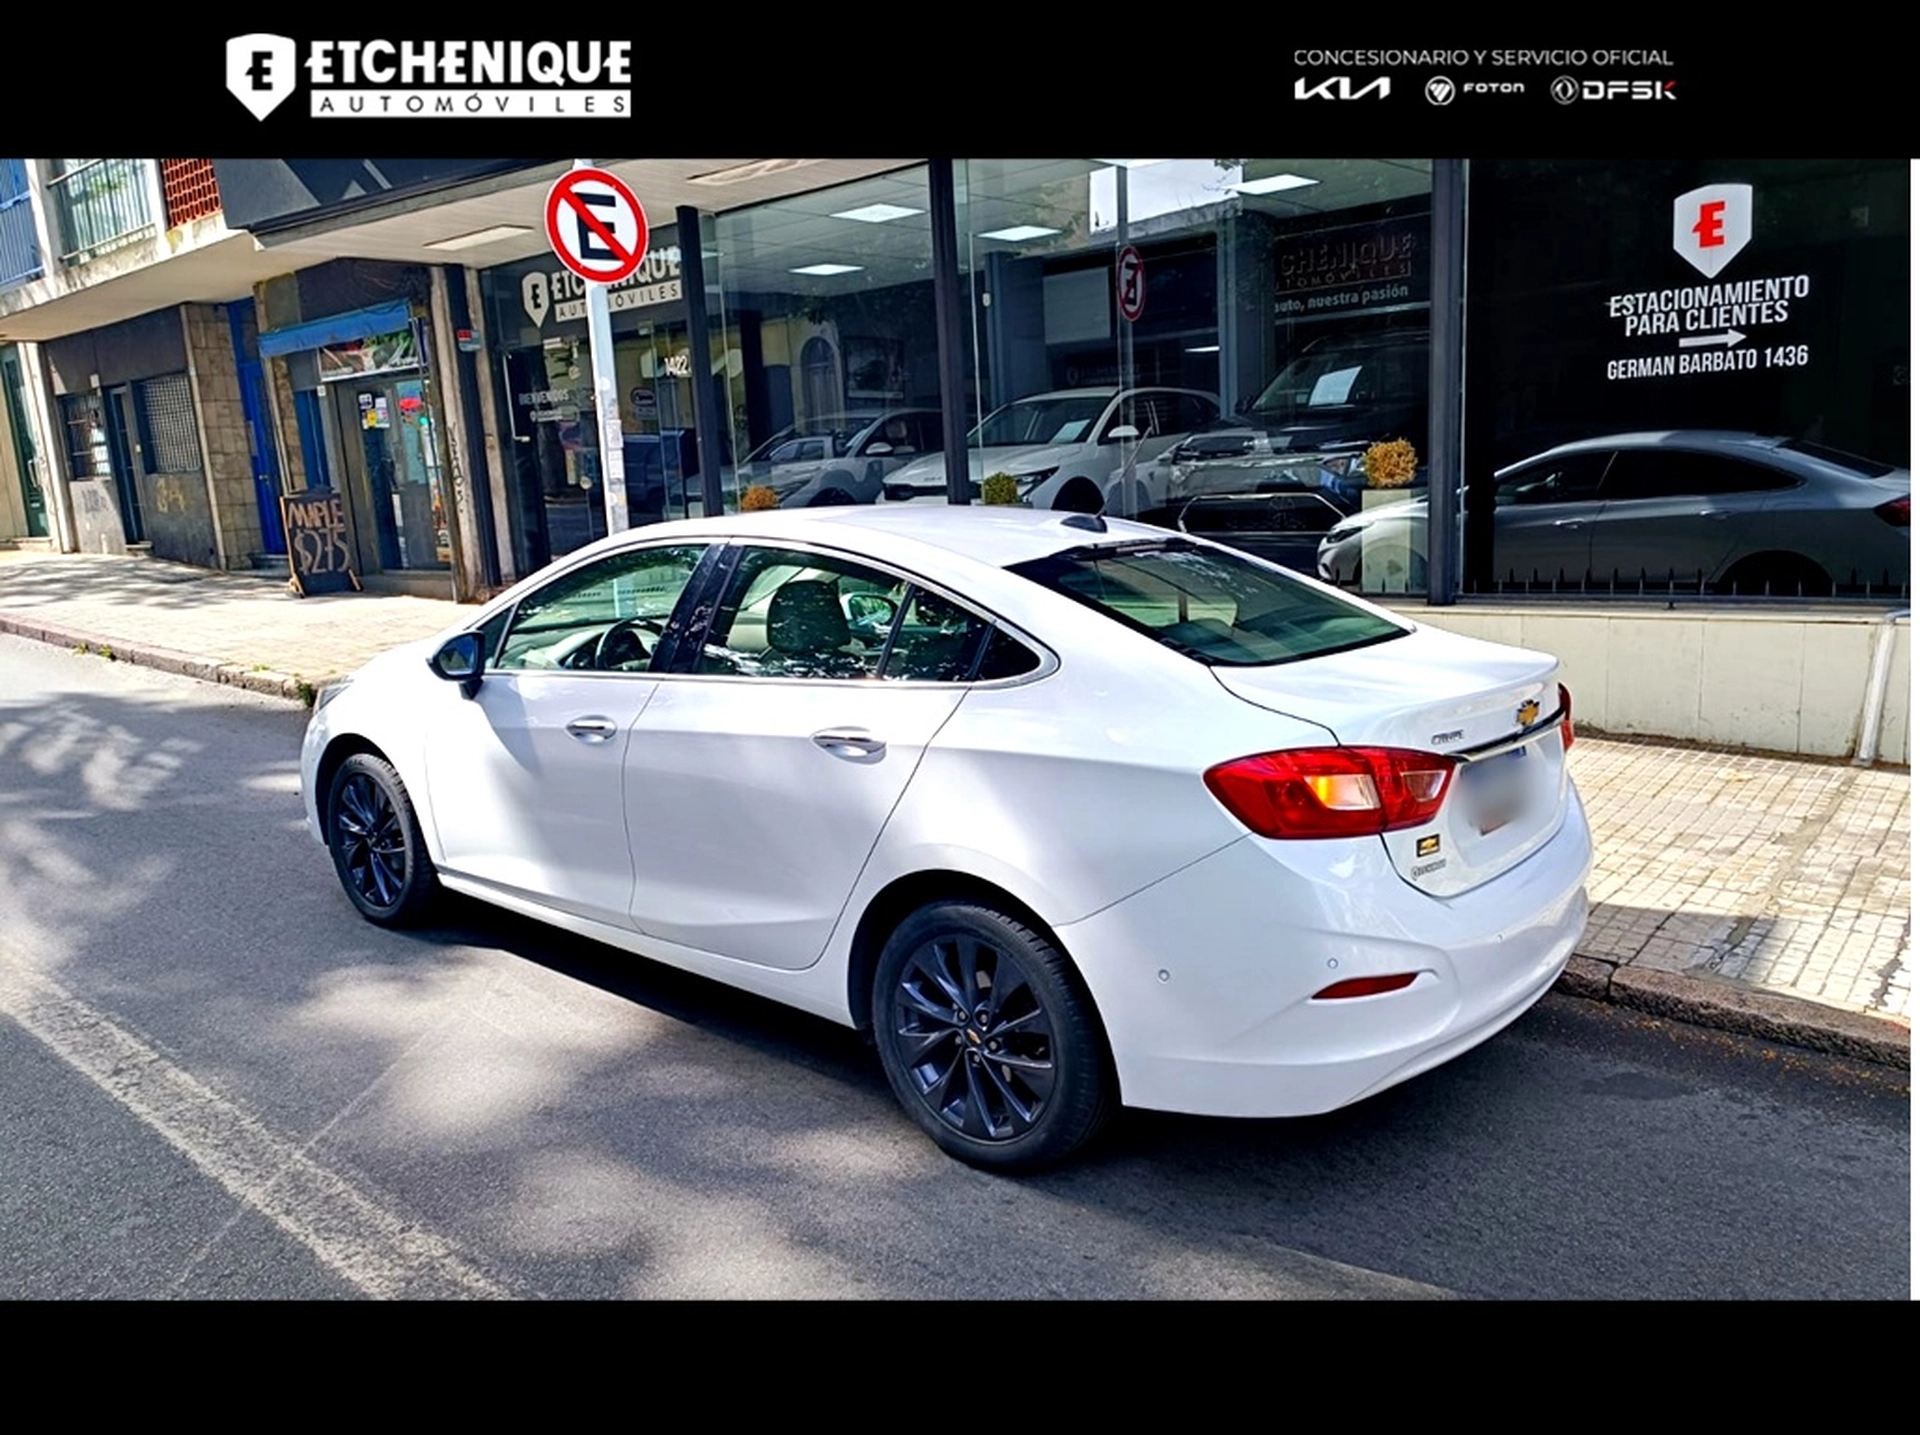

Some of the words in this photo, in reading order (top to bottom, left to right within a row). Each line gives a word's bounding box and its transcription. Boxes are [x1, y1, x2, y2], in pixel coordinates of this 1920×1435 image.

[575, 192, 623, 261] E
[558, 283, 678, 318] AUTÓVILES
[1307, 292, 1359, 309] nuestra
[1362, 283, 1409, 305] pasión
[1609, 275, 1809, 318] ESTACIONAMIENTO
[1625, 311, 1680, 337] PARA
[1685, 300, 1789, 331] CLIENTES
[1607, 355, 1675, 380] GERMAN
[1679, 348, 1757, 374] BARBATO
[1765, 345, 1809, 368] 1436
[289, 500, 344, 529] MAPLE
[294, 528, 349, 575] $275
